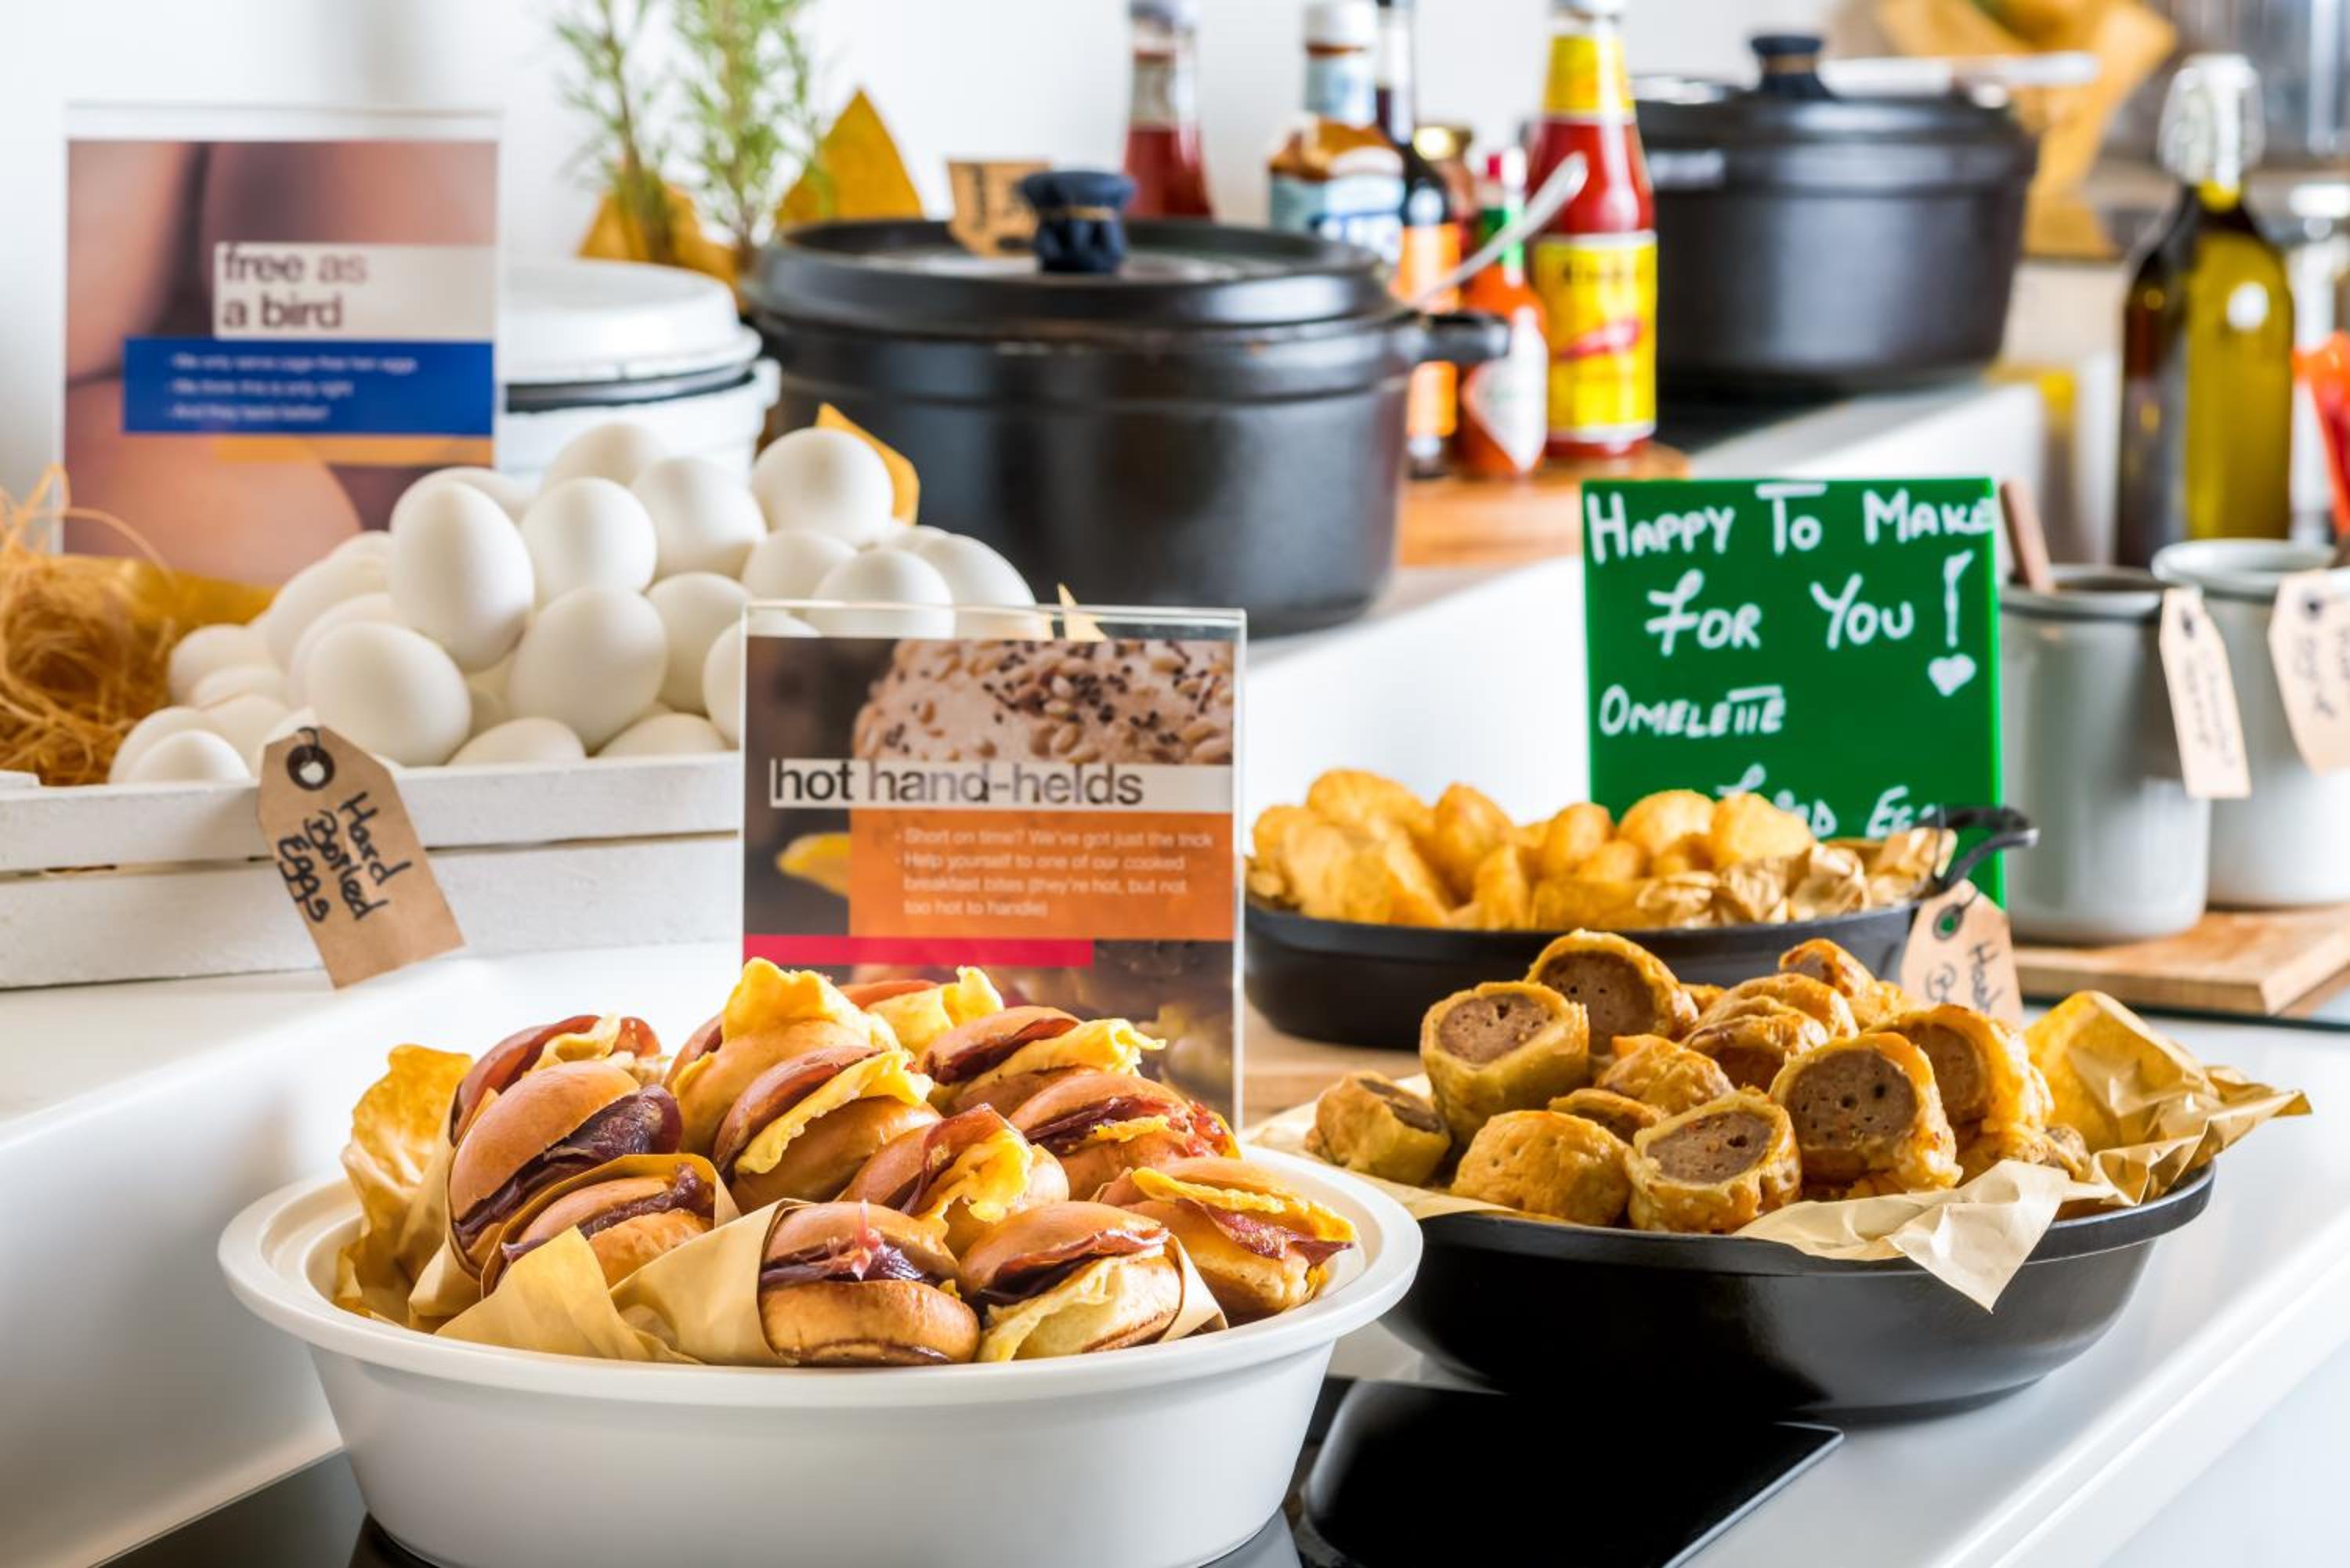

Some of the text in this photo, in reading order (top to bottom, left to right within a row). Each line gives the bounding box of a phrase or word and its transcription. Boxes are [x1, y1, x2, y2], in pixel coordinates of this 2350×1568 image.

[221, 244, 368, 283] free as
[222, 293, 342, 330] a bird
[774, 758, 1144, 806] hot hand-helds
[338, 791, 413, 887] Hard
[903, 827, 950, 845] Short
[952, 831, 976, 844] on
[1083, 832, 1111, 850] got
[1113, 831, 1144, 849] just
[1147, 833, 1174, 847] the
[276, 834, 331, 923] Eggs
[302, 809, 389, 920] Boiled
[903, 851, 1186, 873] Help yourself to one of our cooked
[902, 874, 979, 892] breakfast
[983, 876, 1025, 892] bites
[1128, 879, 1156, 894] but
[1159, 879, 1188, 894] not
[902, 900, 932, 915] too
[934, 900, 964, 915] hot
[966, 901, 985, 915] to
